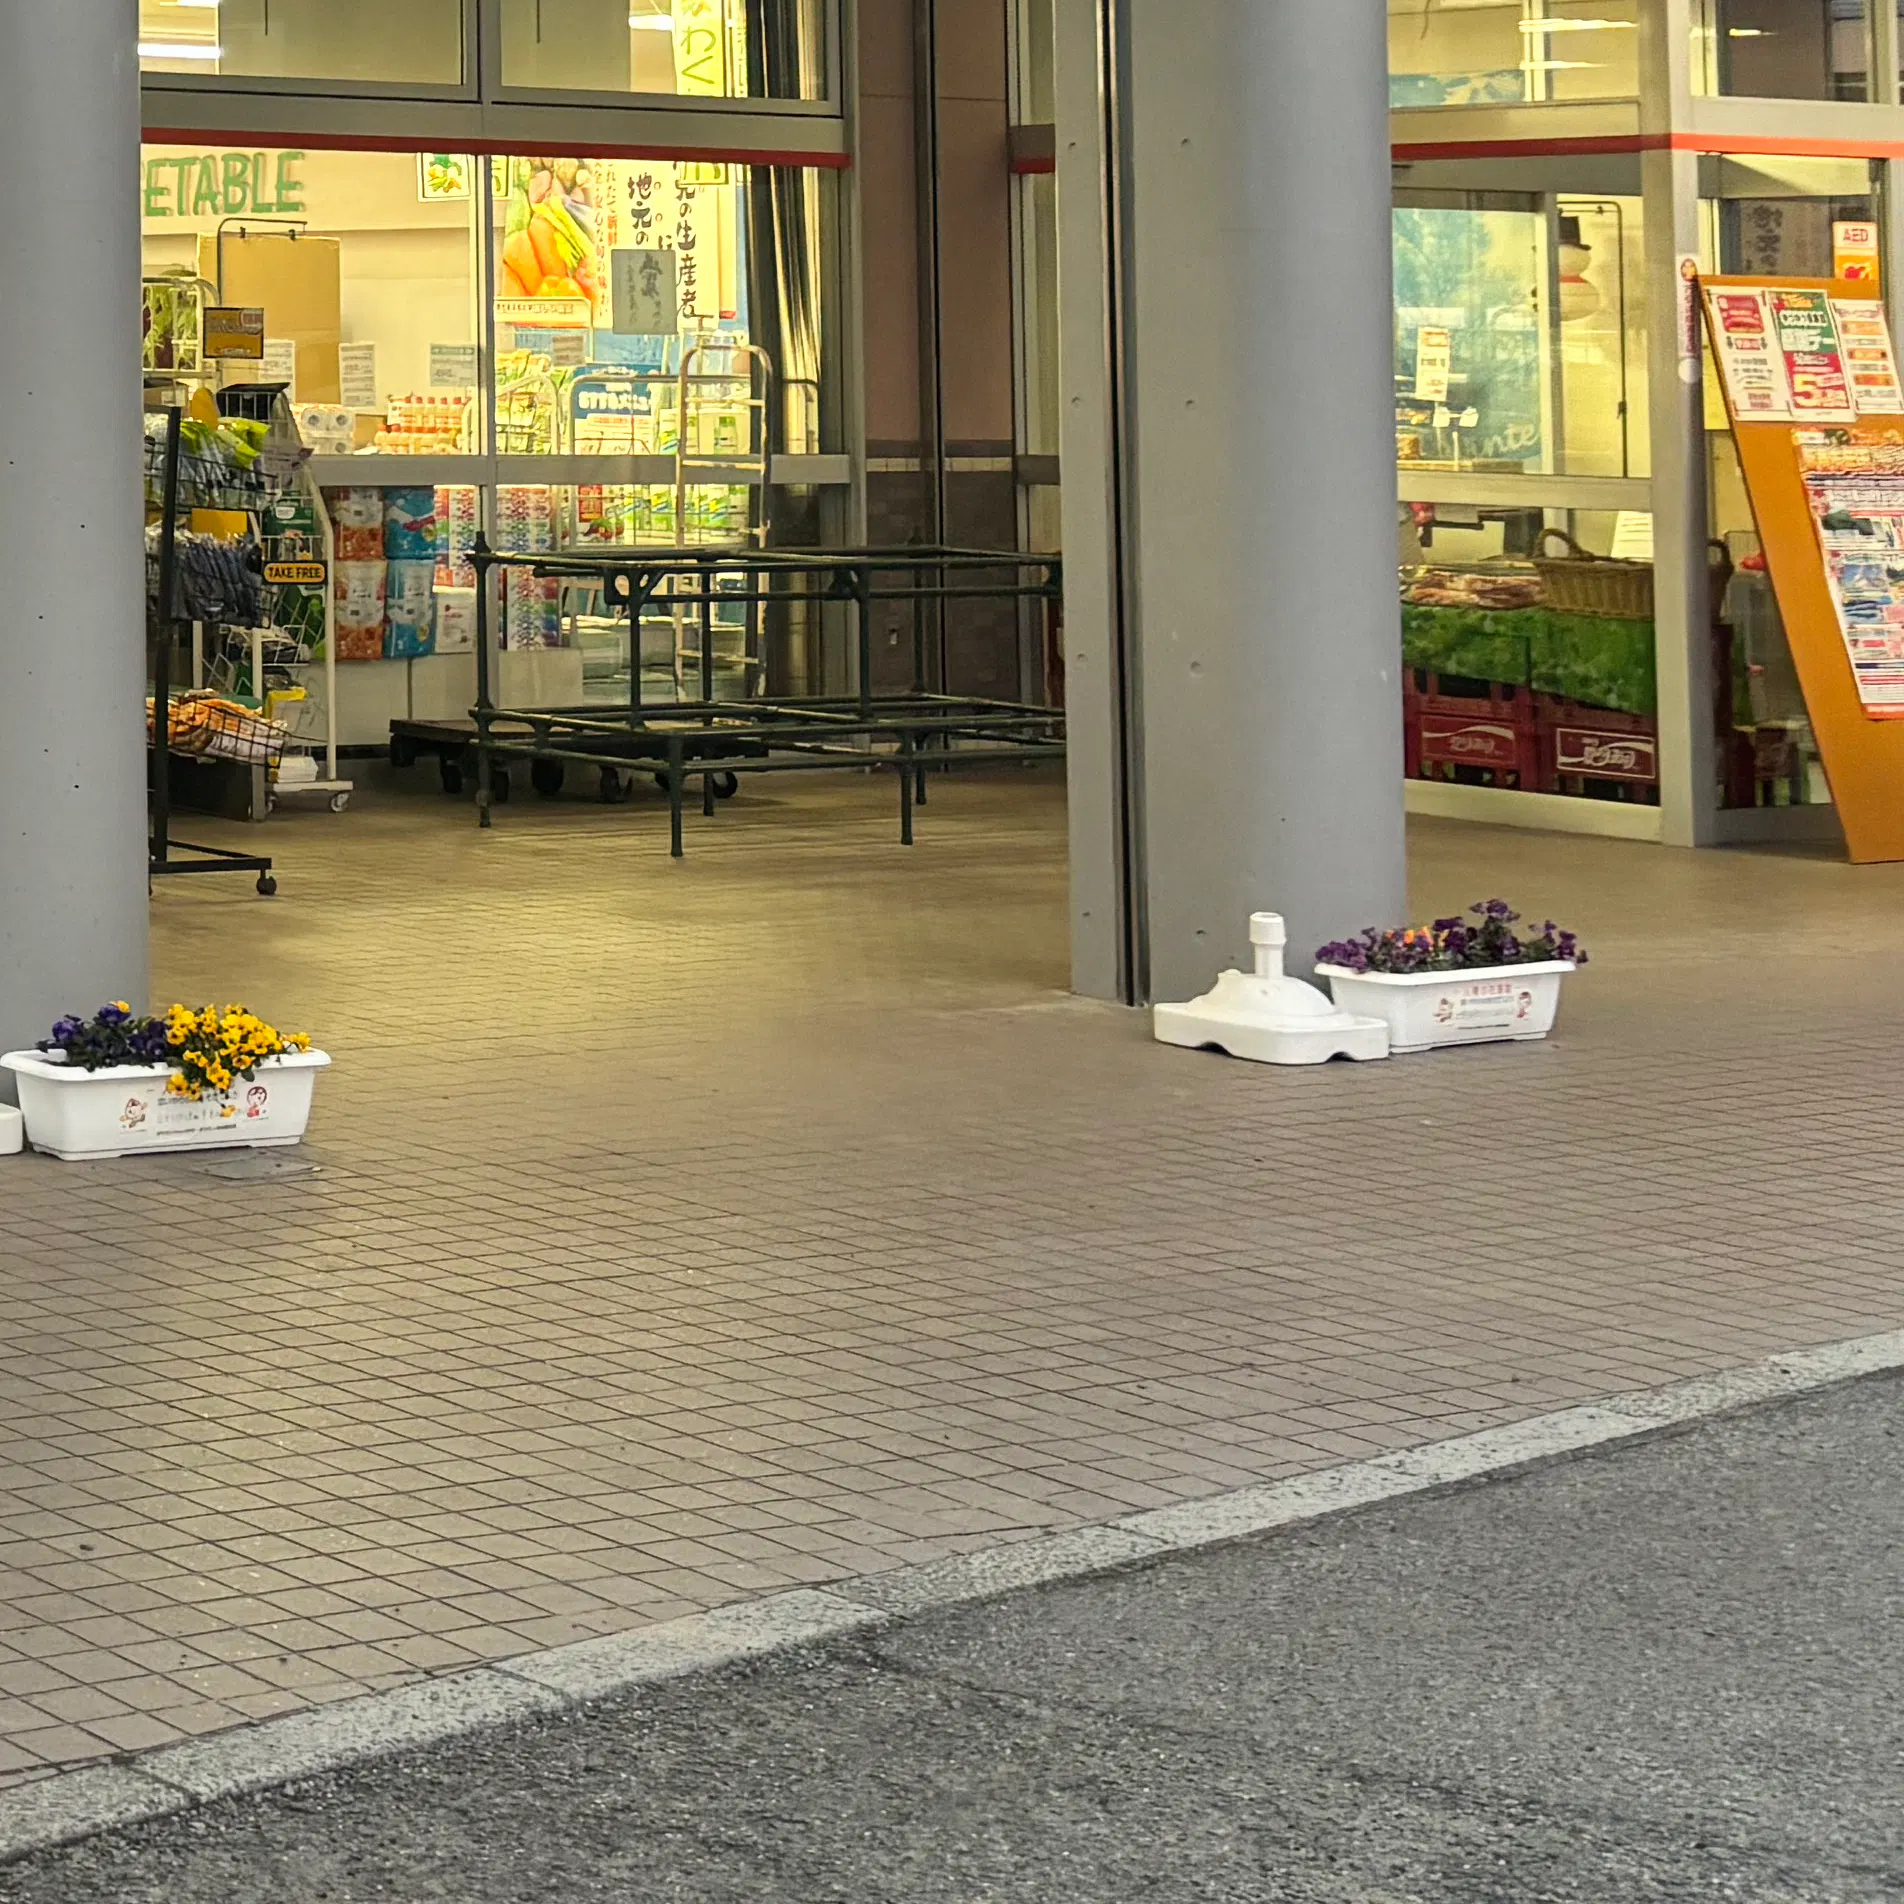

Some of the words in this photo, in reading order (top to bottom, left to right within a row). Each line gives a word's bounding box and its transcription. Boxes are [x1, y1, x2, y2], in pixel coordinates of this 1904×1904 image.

[1843, 228, 1869, 243] AED
[675, 176, 699, 319] 元の生産者
[268, 566, 293, 579] TAKE
[296, 566, 321, 579] FREE
